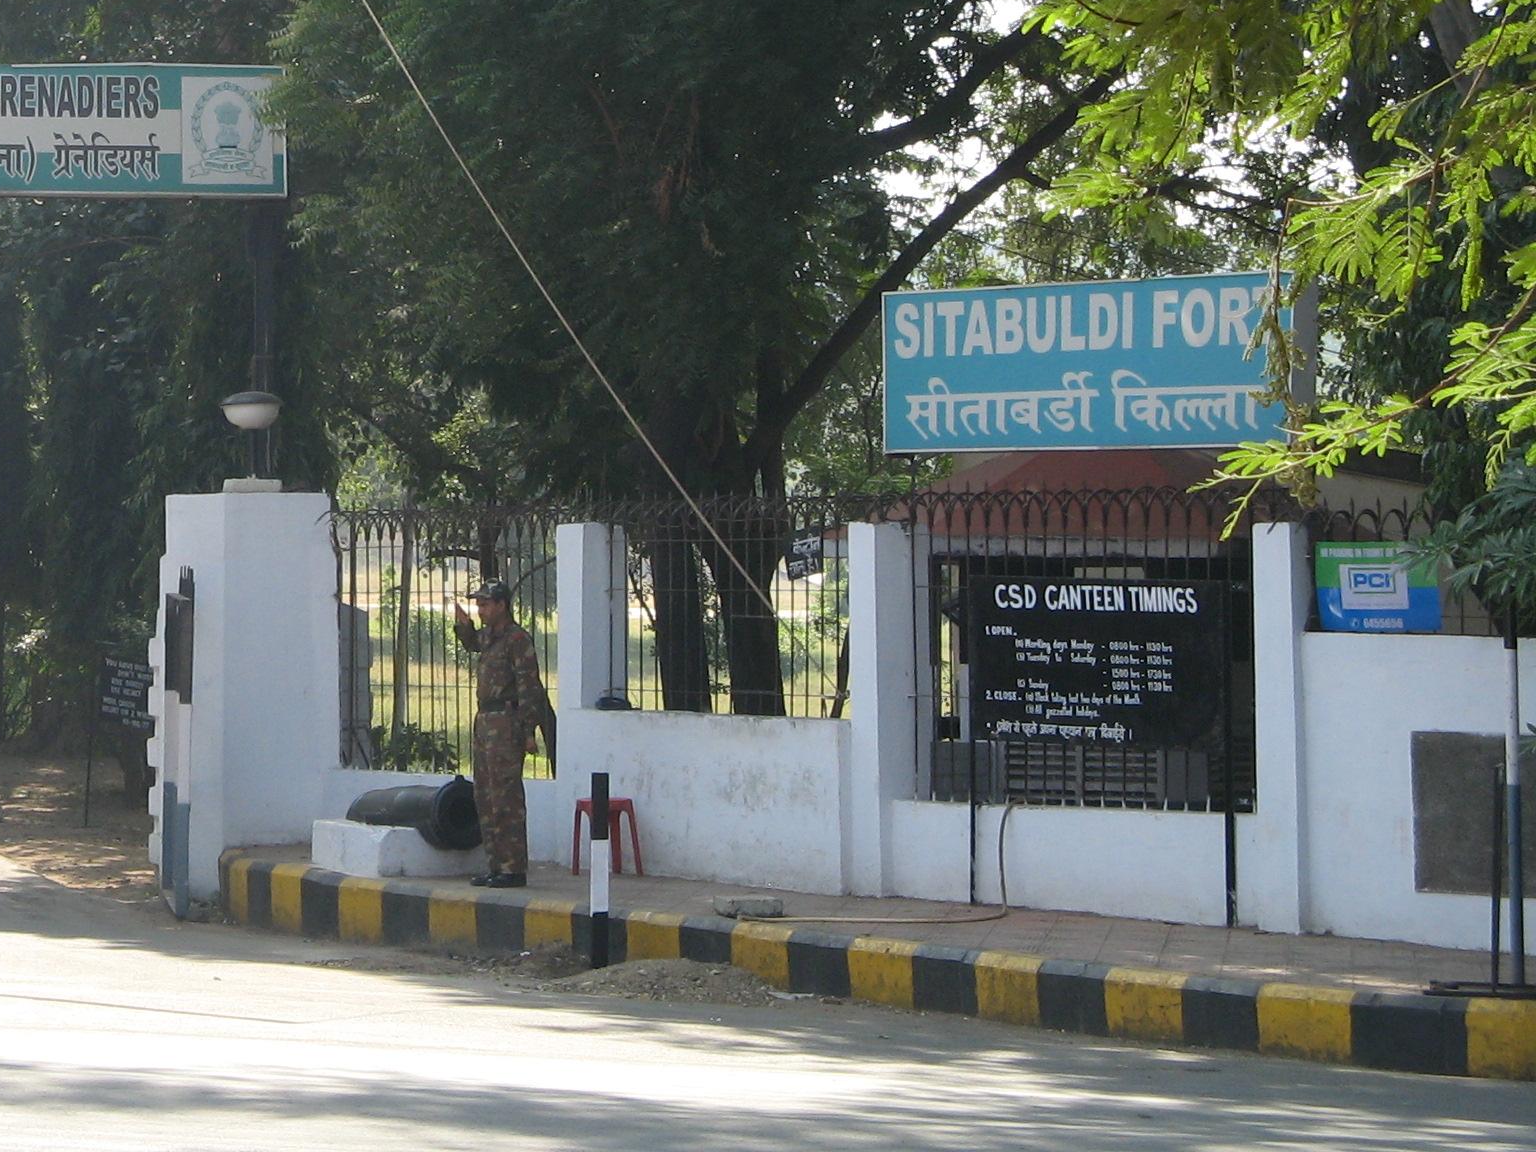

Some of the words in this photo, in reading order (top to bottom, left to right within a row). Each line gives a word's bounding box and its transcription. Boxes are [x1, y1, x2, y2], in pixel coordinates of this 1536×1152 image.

[894, 291, 1135, 359] SITABULDI
[1110, 368, 1270, 432] किल्ला
[994, 583, 1037, 610] CSD
[1044, 584, 1125, 613] CANTEEN
[1128, 586, 1199, 614] TIMINGS
